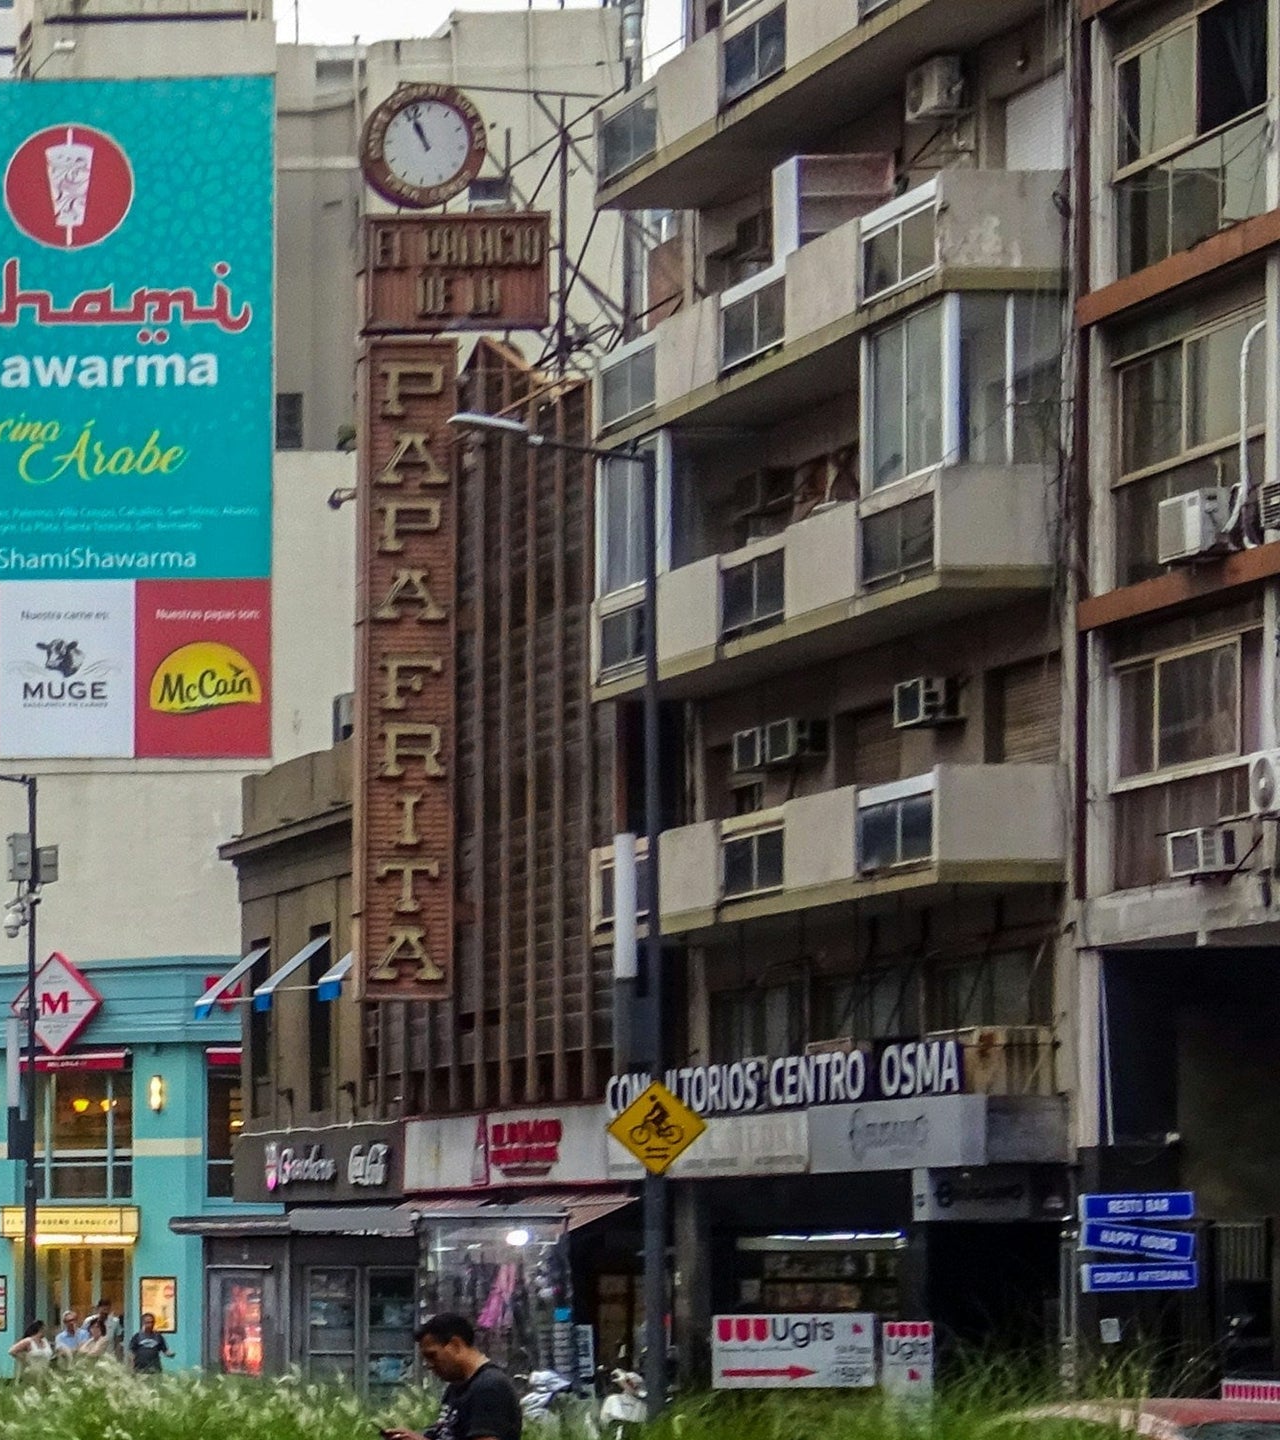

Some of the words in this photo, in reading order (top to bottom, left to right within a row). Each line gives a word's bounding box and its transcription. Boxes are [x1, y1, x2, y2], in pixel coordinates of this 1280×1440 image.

[17, 418, 190, 484] Árabe
[22, 681, 108, 701] MUGE
[158, 663, 254, 704] McCain
[41, 990, 70, 1016] M
[605, 1061, 760, 1116] COLTORIOS
[769, 1049, 867, 1107] CENTRO
[880, 1040, 962, 1097] OSMA
[1145, 1198, 1170, 1213] BAR
[1099, 1229, 1140, 1247] HAPPY
[1140, 1234, 1178, 1252] HOURS
